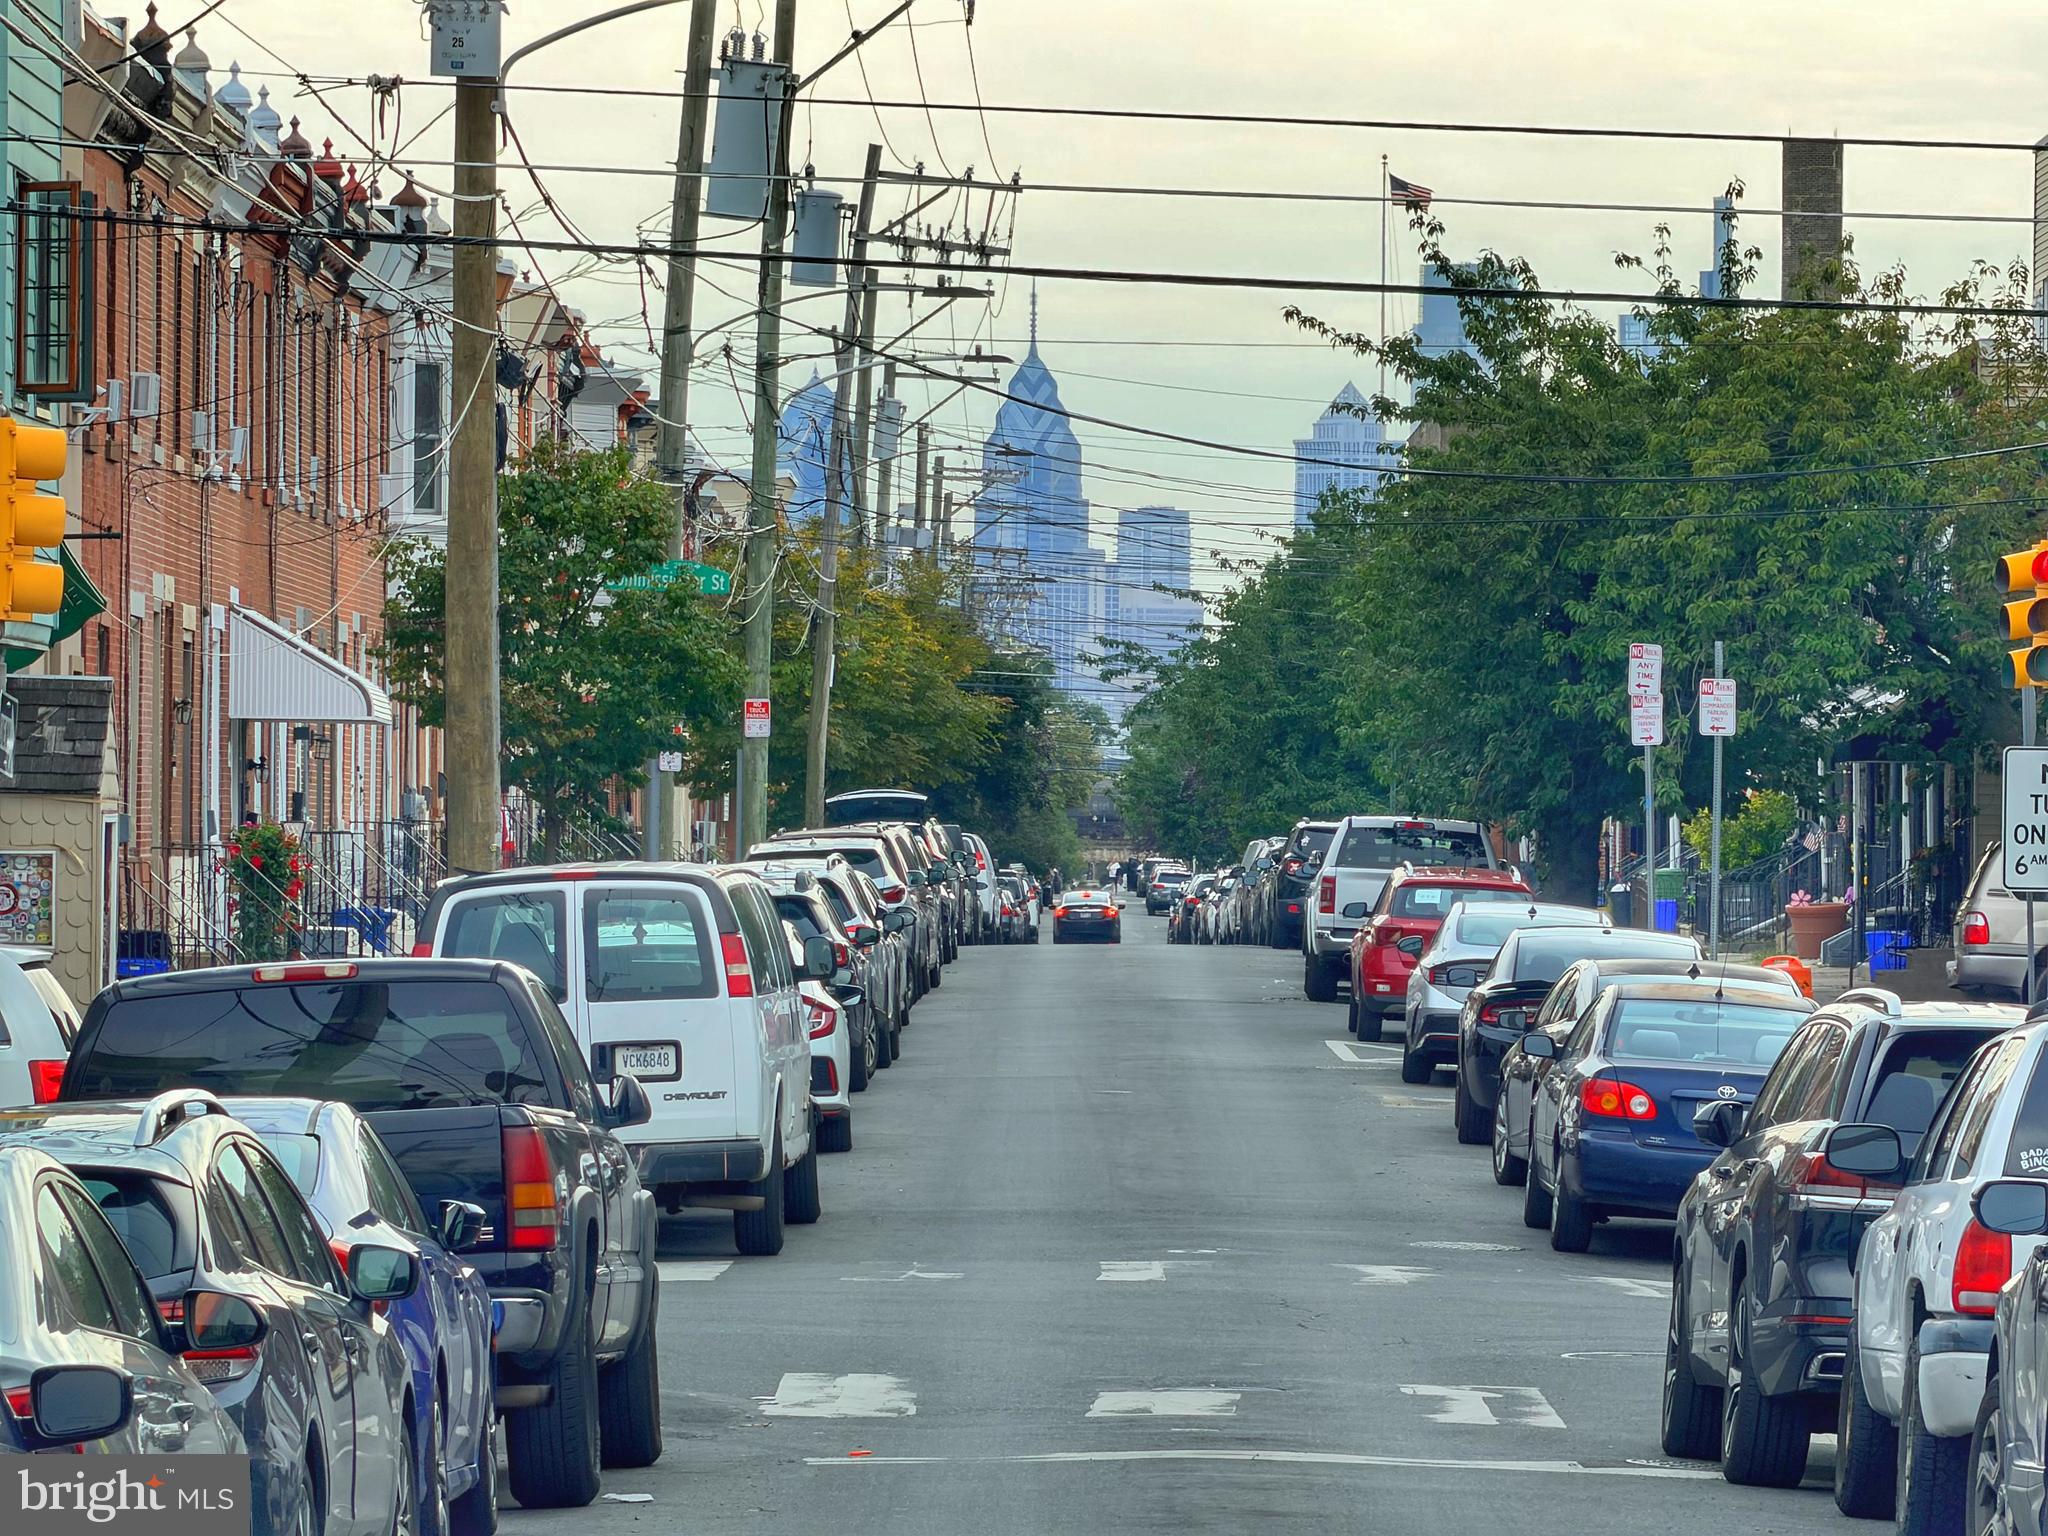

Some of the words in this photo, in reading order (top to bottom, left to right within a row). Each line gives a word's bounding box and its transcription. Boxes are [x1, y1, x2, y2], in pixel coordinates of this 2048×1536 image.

[452, 37, 464, 48] 25
[711, 574, 725, 591] St
[1632, 646, 1643, 658] NO
[1637, 662, 1655, 670] ANY
[1637, 671, 1655, 680] TIME
[1702, 682, 1713, 694] NO
[1633, 695, 1643, 706] NO
[2014, 824, 2046, 845] ON
[622, 1052, 670, 1068] VCK6848
[663, 1091, 727, 1101] CHEVROLET
